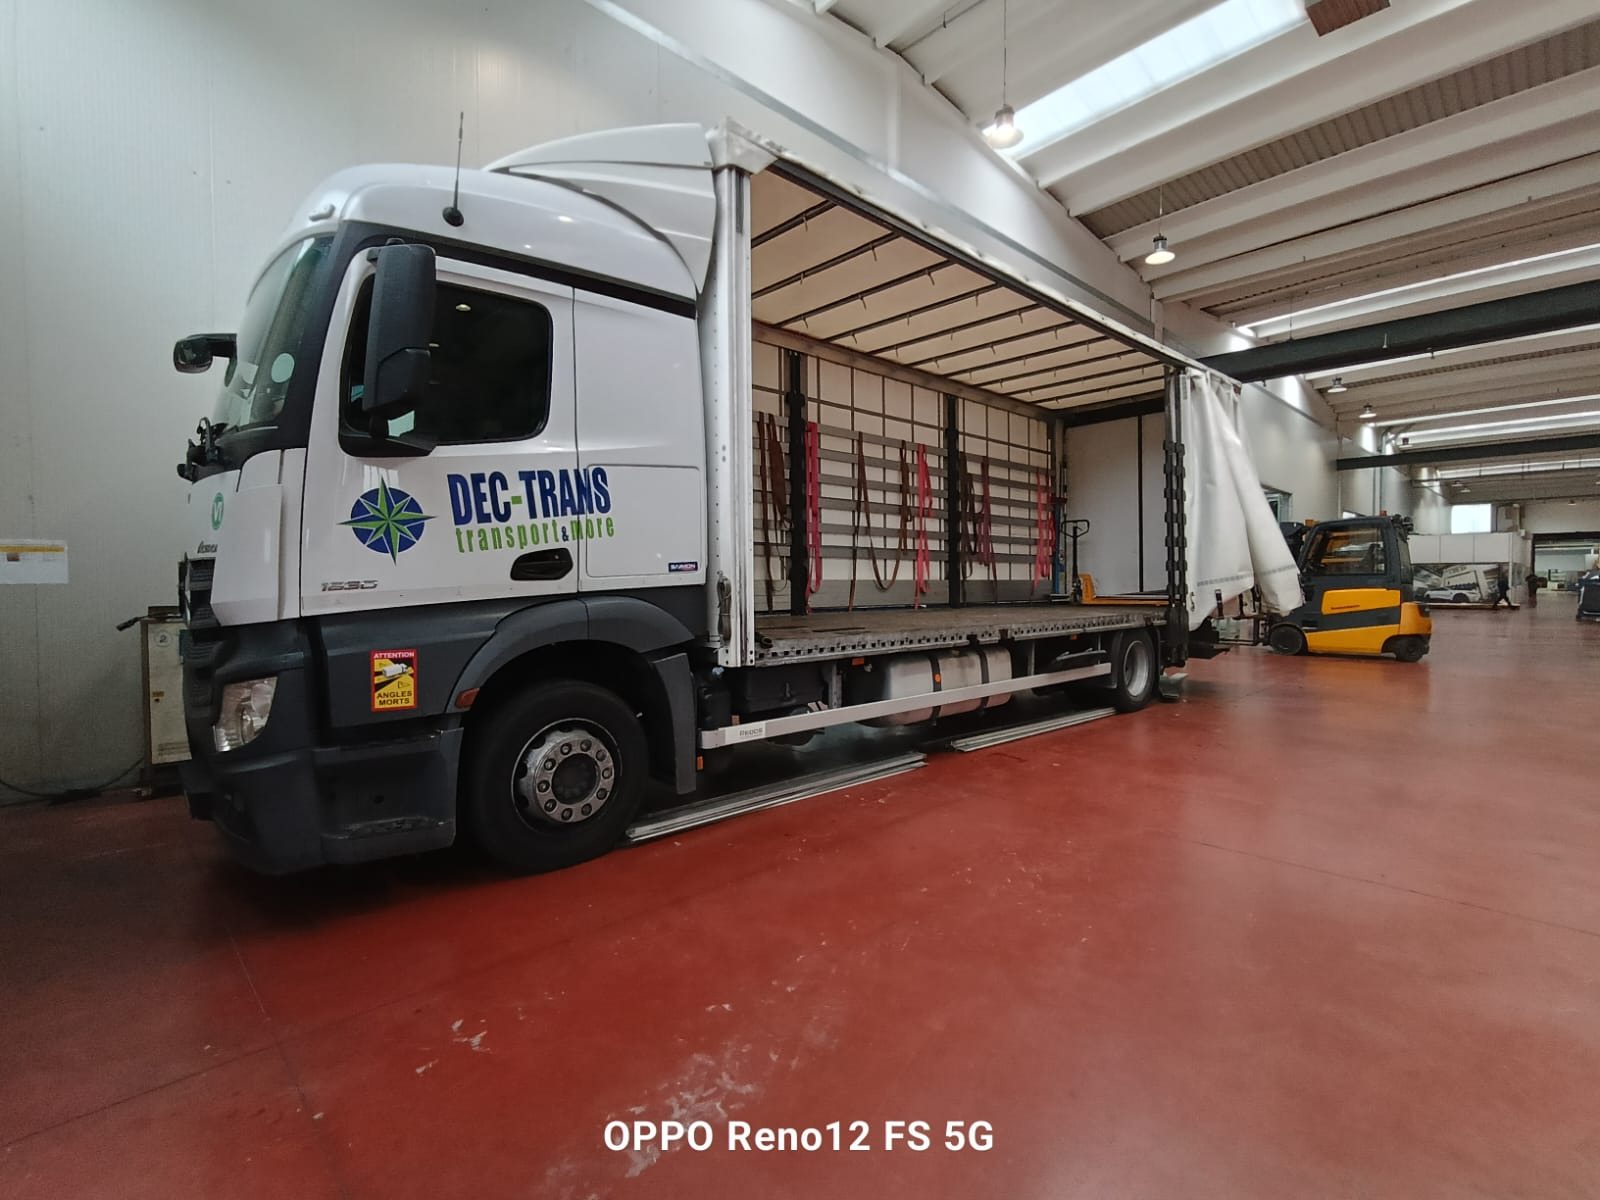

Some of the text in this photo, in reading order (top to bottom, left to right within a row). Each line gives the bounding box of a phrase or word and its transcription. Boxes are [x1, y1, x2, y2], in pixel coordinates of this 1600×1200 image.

[447, 467, 612, 526] DEC-TRANS
[377, 690, 413, 699] ANGLES
[378, 698, 410, 706] MORTS
